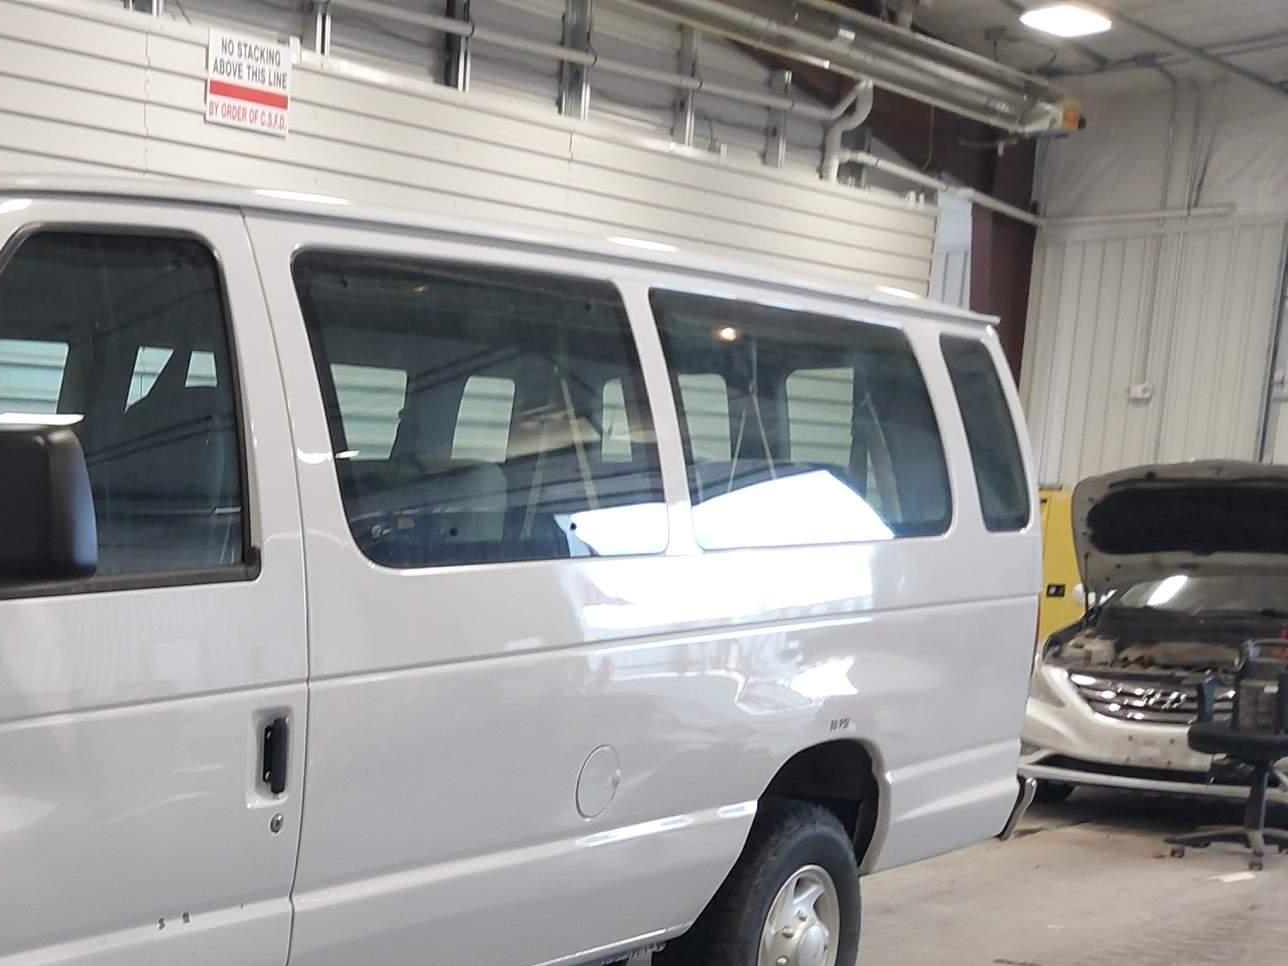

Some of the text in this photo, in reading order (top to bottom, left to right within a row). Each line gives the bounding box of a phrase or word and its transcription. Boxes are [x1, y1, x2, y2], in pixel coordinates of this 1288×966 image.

[221, 37, 281, 67] NO STACKING
[213, 58, 287, 89] ABOVE THIS LINE
[209, 101, 219, 116] BY
[221, 104, 247, 122] ORDER
[249, 109, 258, 124] OF
